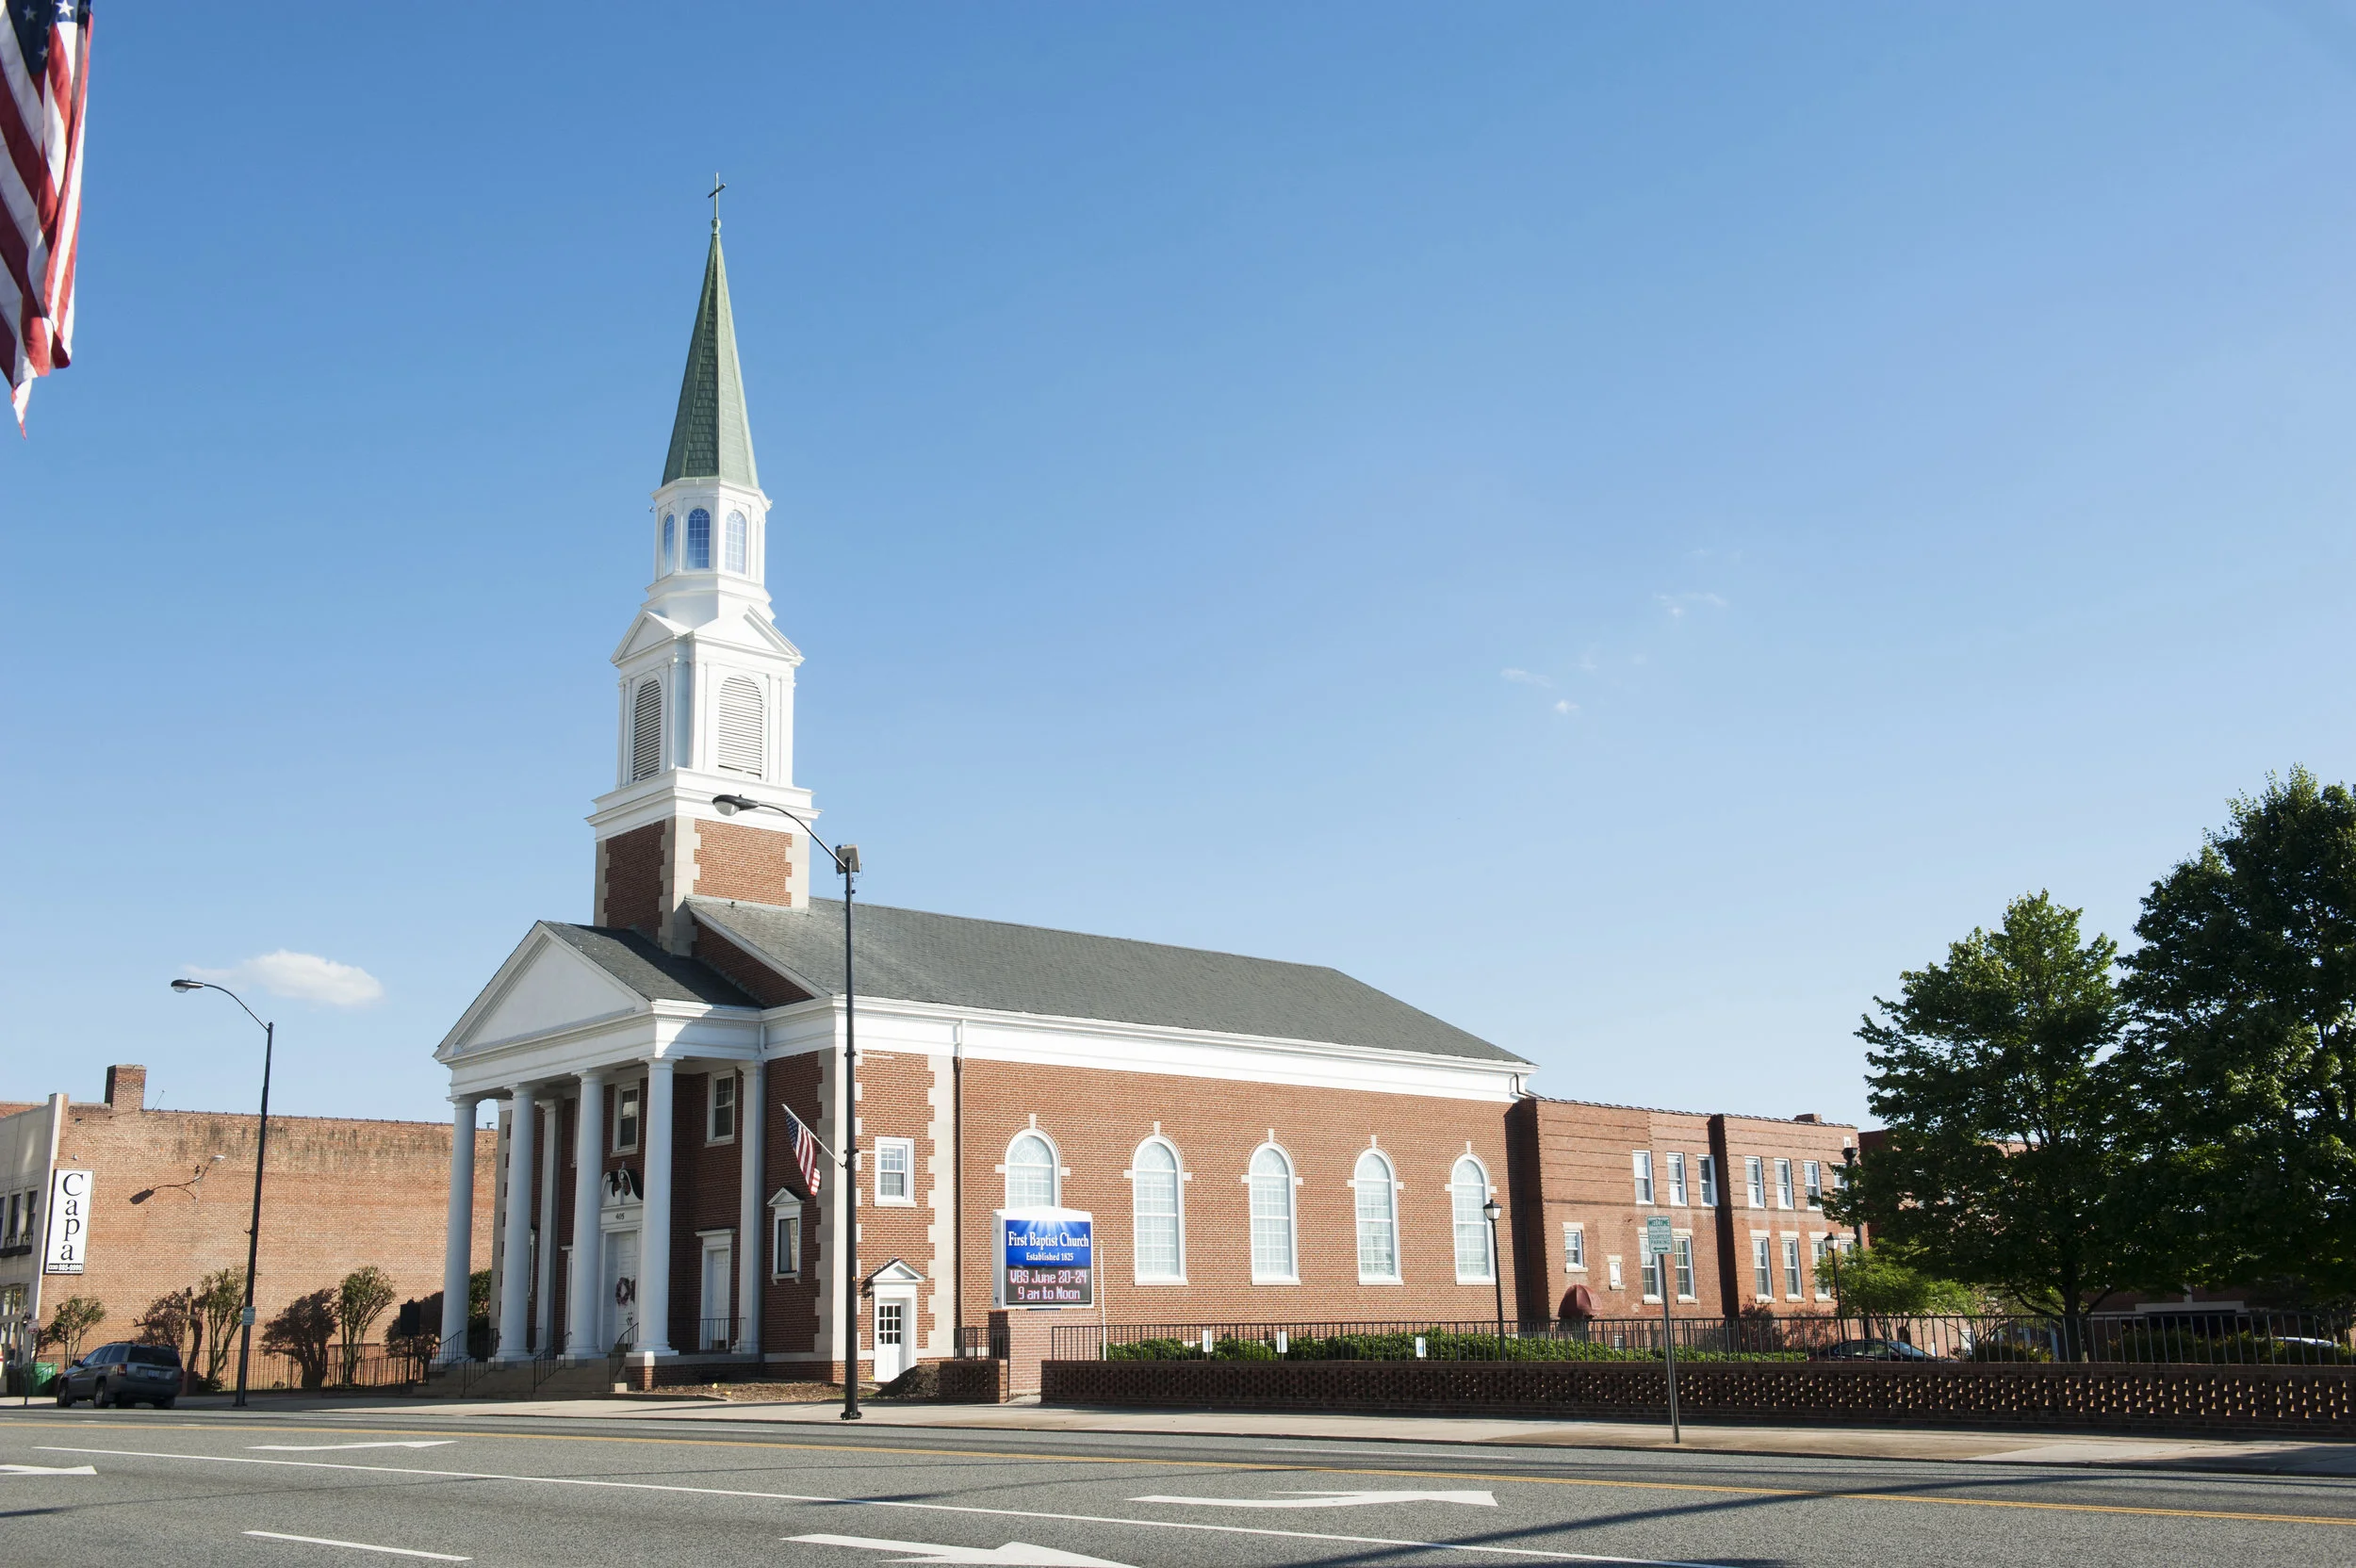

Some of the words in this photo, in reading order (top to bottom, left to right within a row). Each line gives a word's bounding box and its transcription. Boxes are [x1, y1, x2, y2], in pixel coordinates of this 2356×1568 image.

[60, 1172, 83, 1261] Capa
[1007, 1231, 1027, 1247] First
[1029, 1231, 1058, 1250] Baptist
[1059, 1232, 1089, 1248] Church
[1025, 1251, 1060, 1261] Established
[1061, 1252, 1074, 1262] 1825
[1009, 1269, 1029, 1283] VBS
[1031, 1269, 1056, 1283] June
[1057, 1269, 1088, 1284] 20-24
[1018, 1286, 1025, 1299] 9
[1026, 1289, 1040, 1299] am
[1042, 1286, 1054, 1300] to
[1055, 1286, 1081, 1300] Noon
